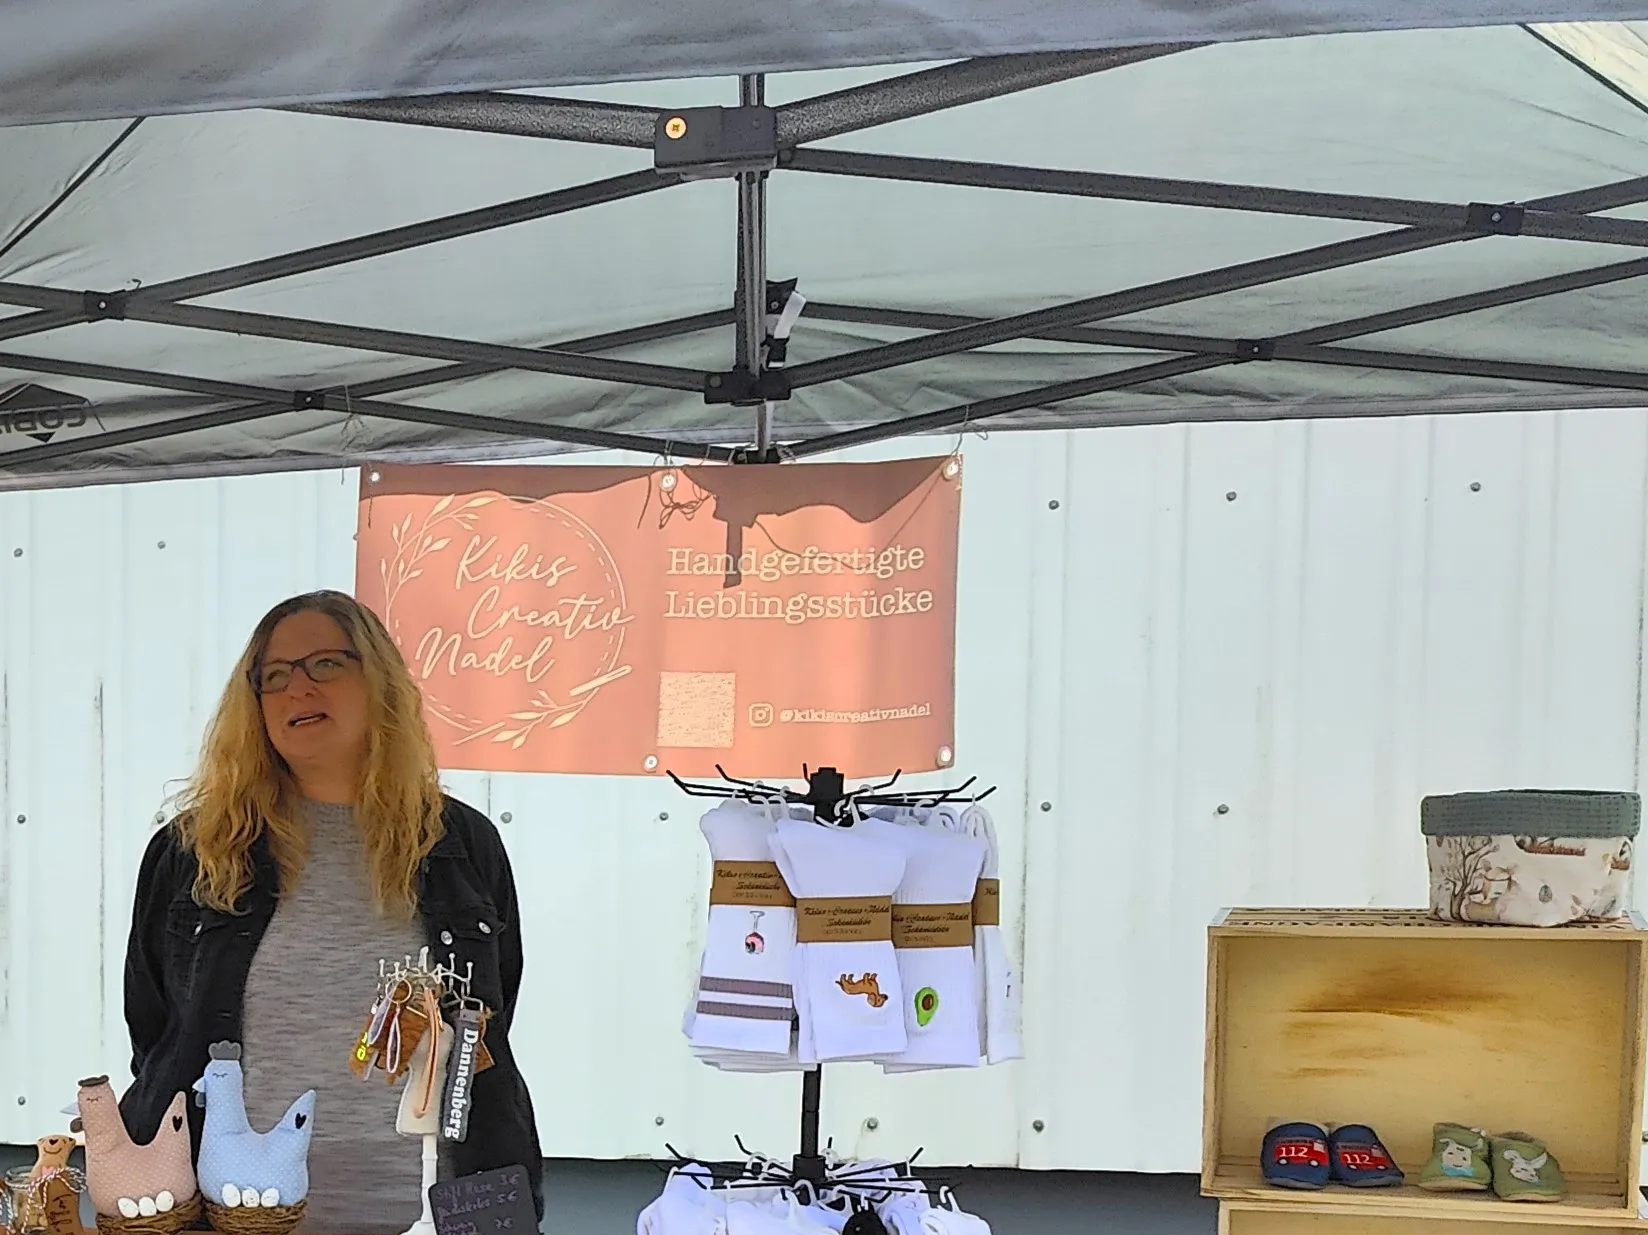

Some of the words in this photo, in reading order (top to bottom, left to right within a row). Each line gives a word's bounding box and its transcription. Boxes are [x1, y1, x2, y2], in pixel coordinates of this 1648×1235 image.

[455, 534, 577, 590] Kikis
[665, 545, 926, 582] Handgefertigte
[466, 585, 635, 640] Creativ
[663, 586, 934, 625] Lieblingsstücke
[415, 627, 556, 683] Nadel
[444, 1027, 479, 1140] Dannenberg
[1279, 1146, 1309, 1157] 112
[1342, 1153, 1375, 1165] 112
